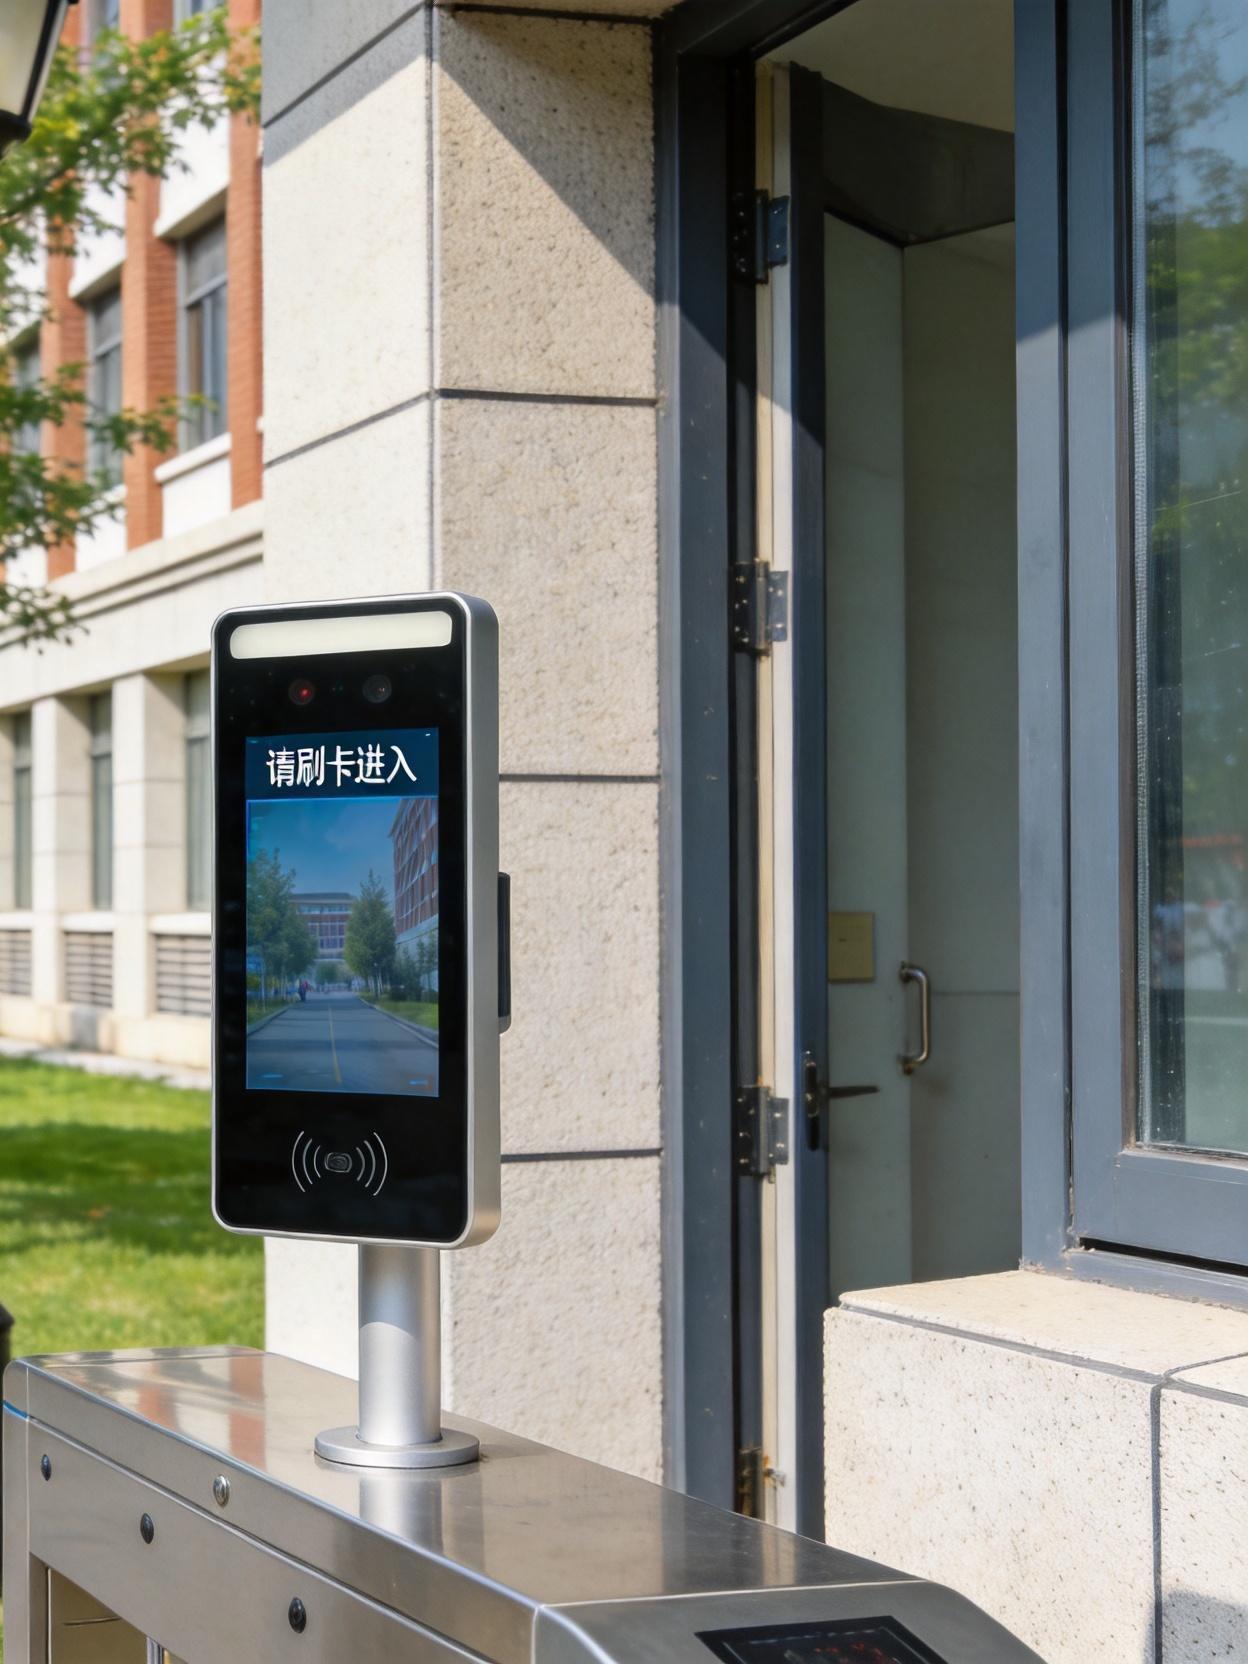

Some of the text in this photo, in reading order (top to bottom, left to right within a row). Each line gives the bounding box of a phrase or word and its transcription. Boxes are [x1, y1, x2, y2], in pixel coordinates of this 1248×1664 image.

[266, 743, 418, 787] 请刷卡进入
